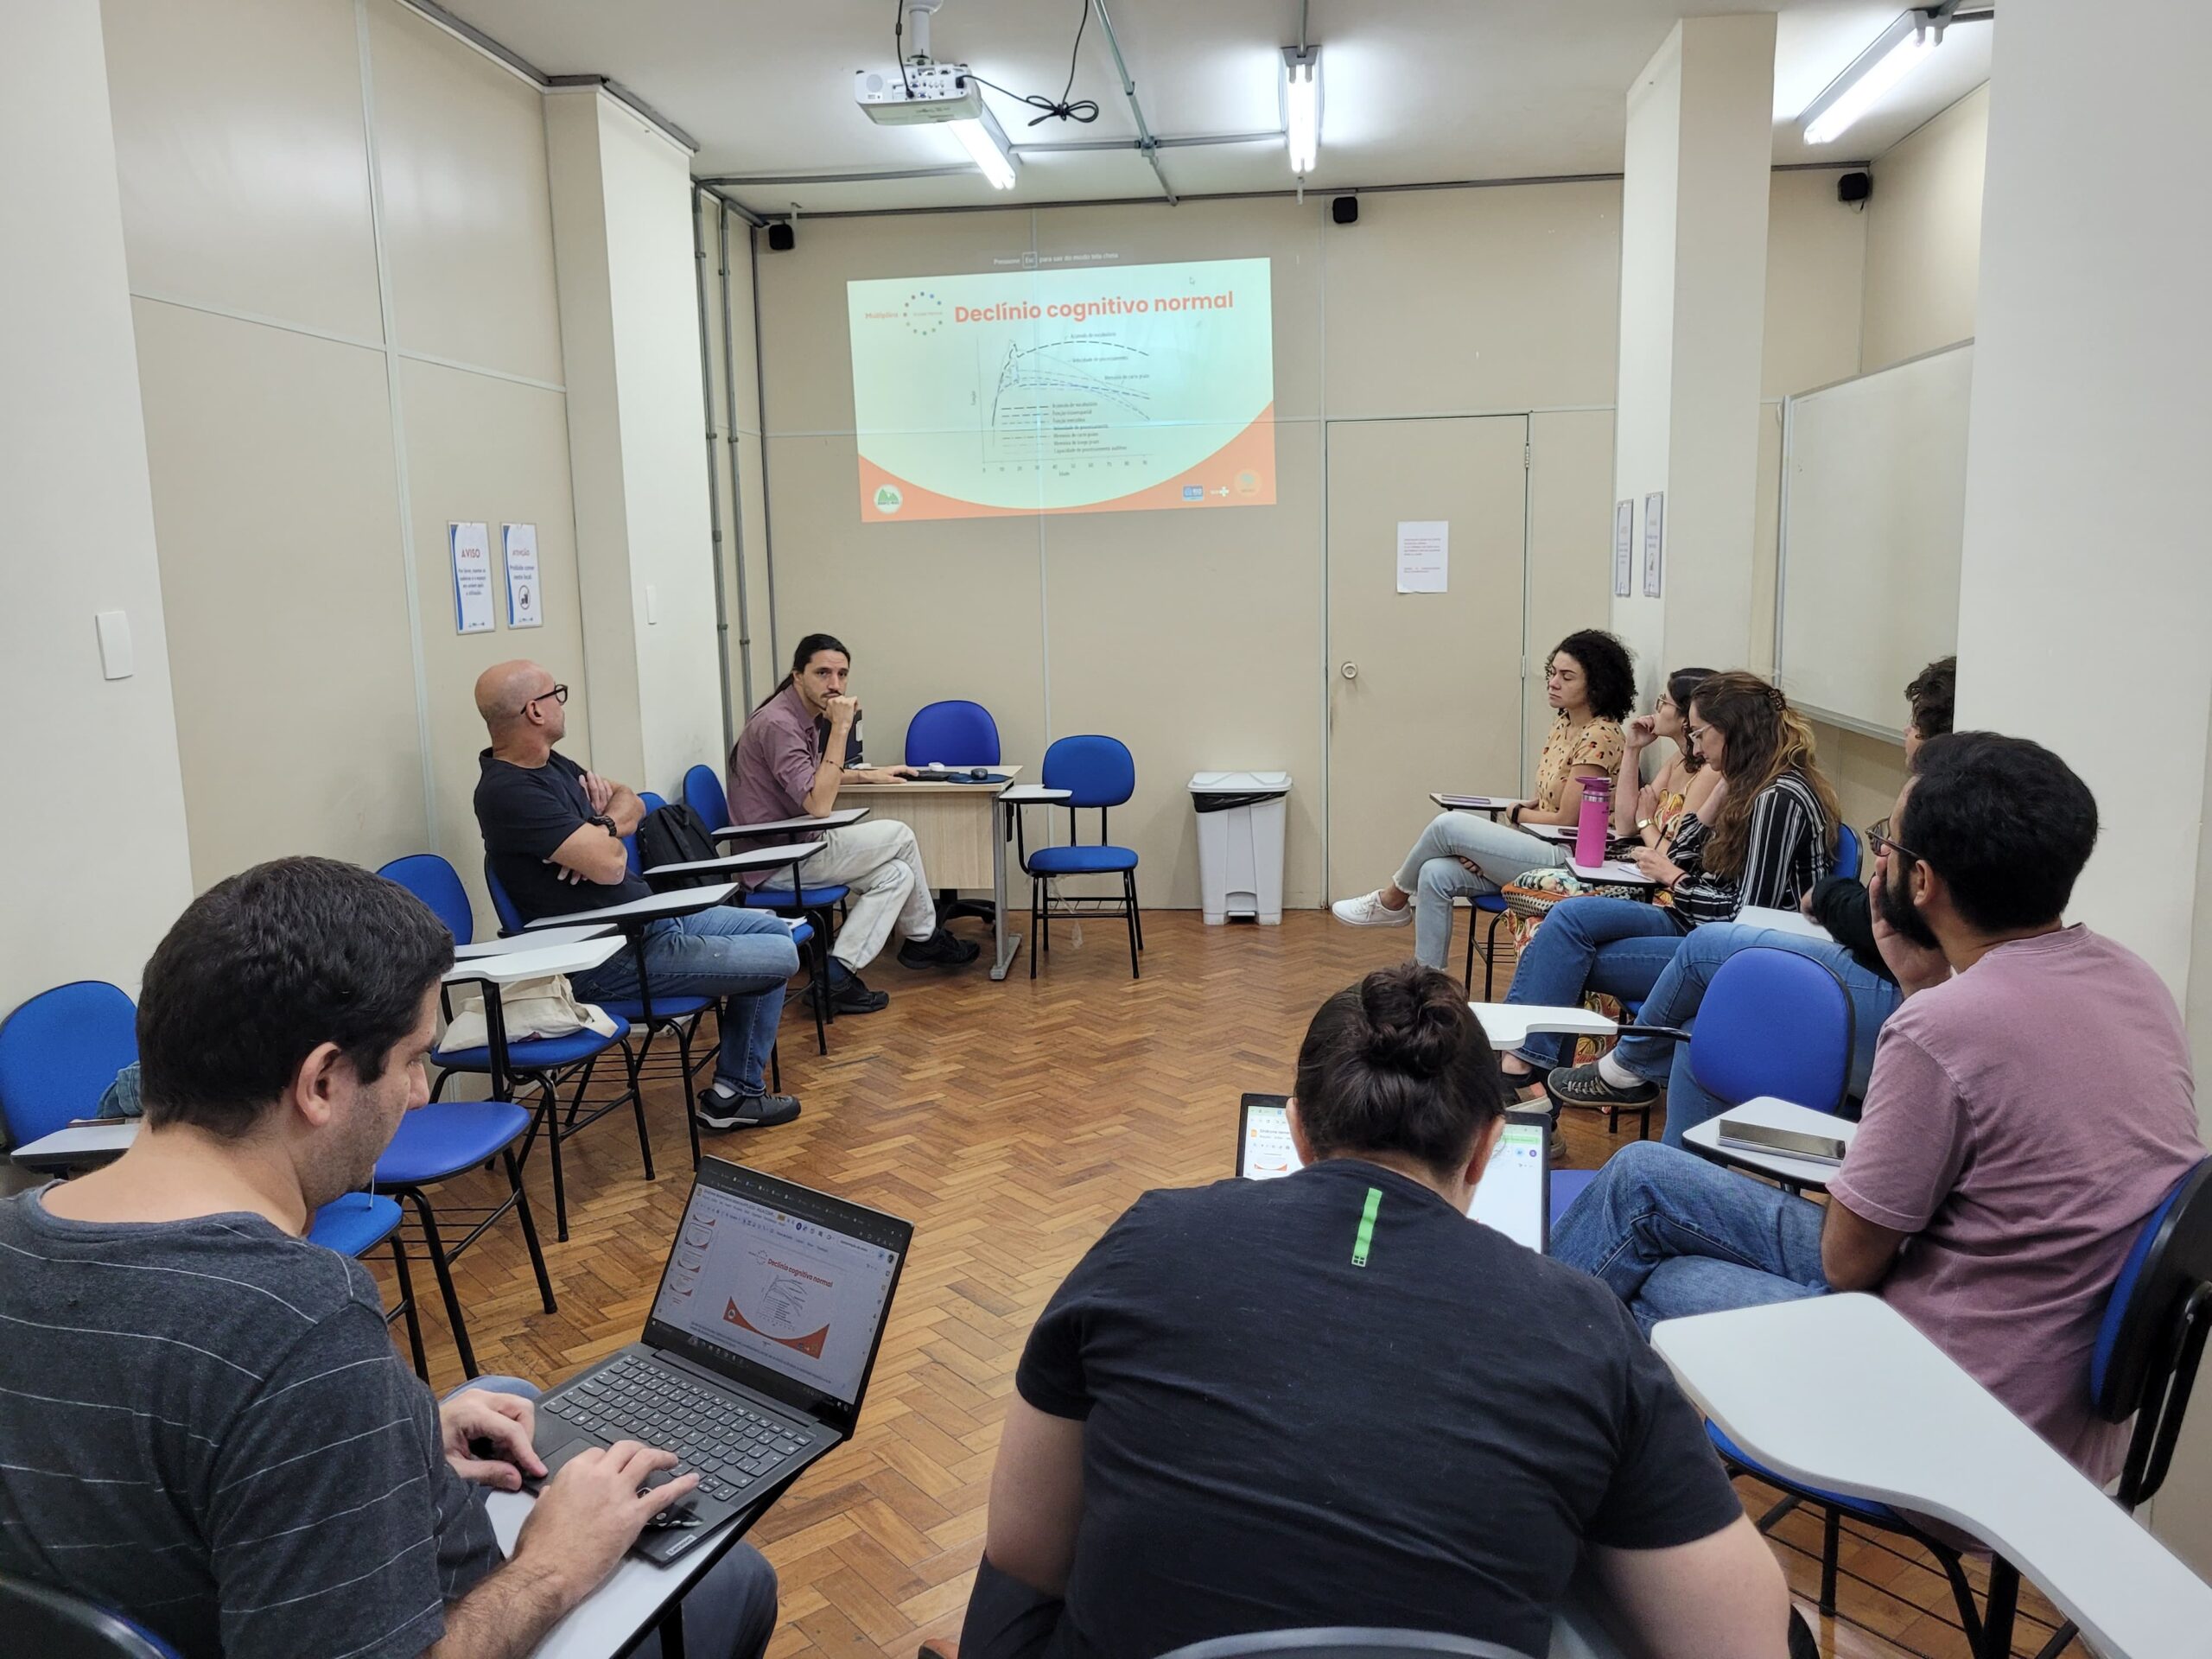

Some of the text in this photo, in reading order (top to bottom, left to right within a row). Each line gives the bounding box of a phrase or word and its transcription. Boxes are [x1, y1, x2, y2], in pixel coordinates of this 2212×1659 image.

[955, 290, 1234, 323] Declínio cognitivo normal
[461, 549, 480, 558] AVISO
[788, 1267, 812, 1281] cognitivo
[813, 1276, 834, 1287] normal
[669, 1536, 693, 1554] Lenovo
